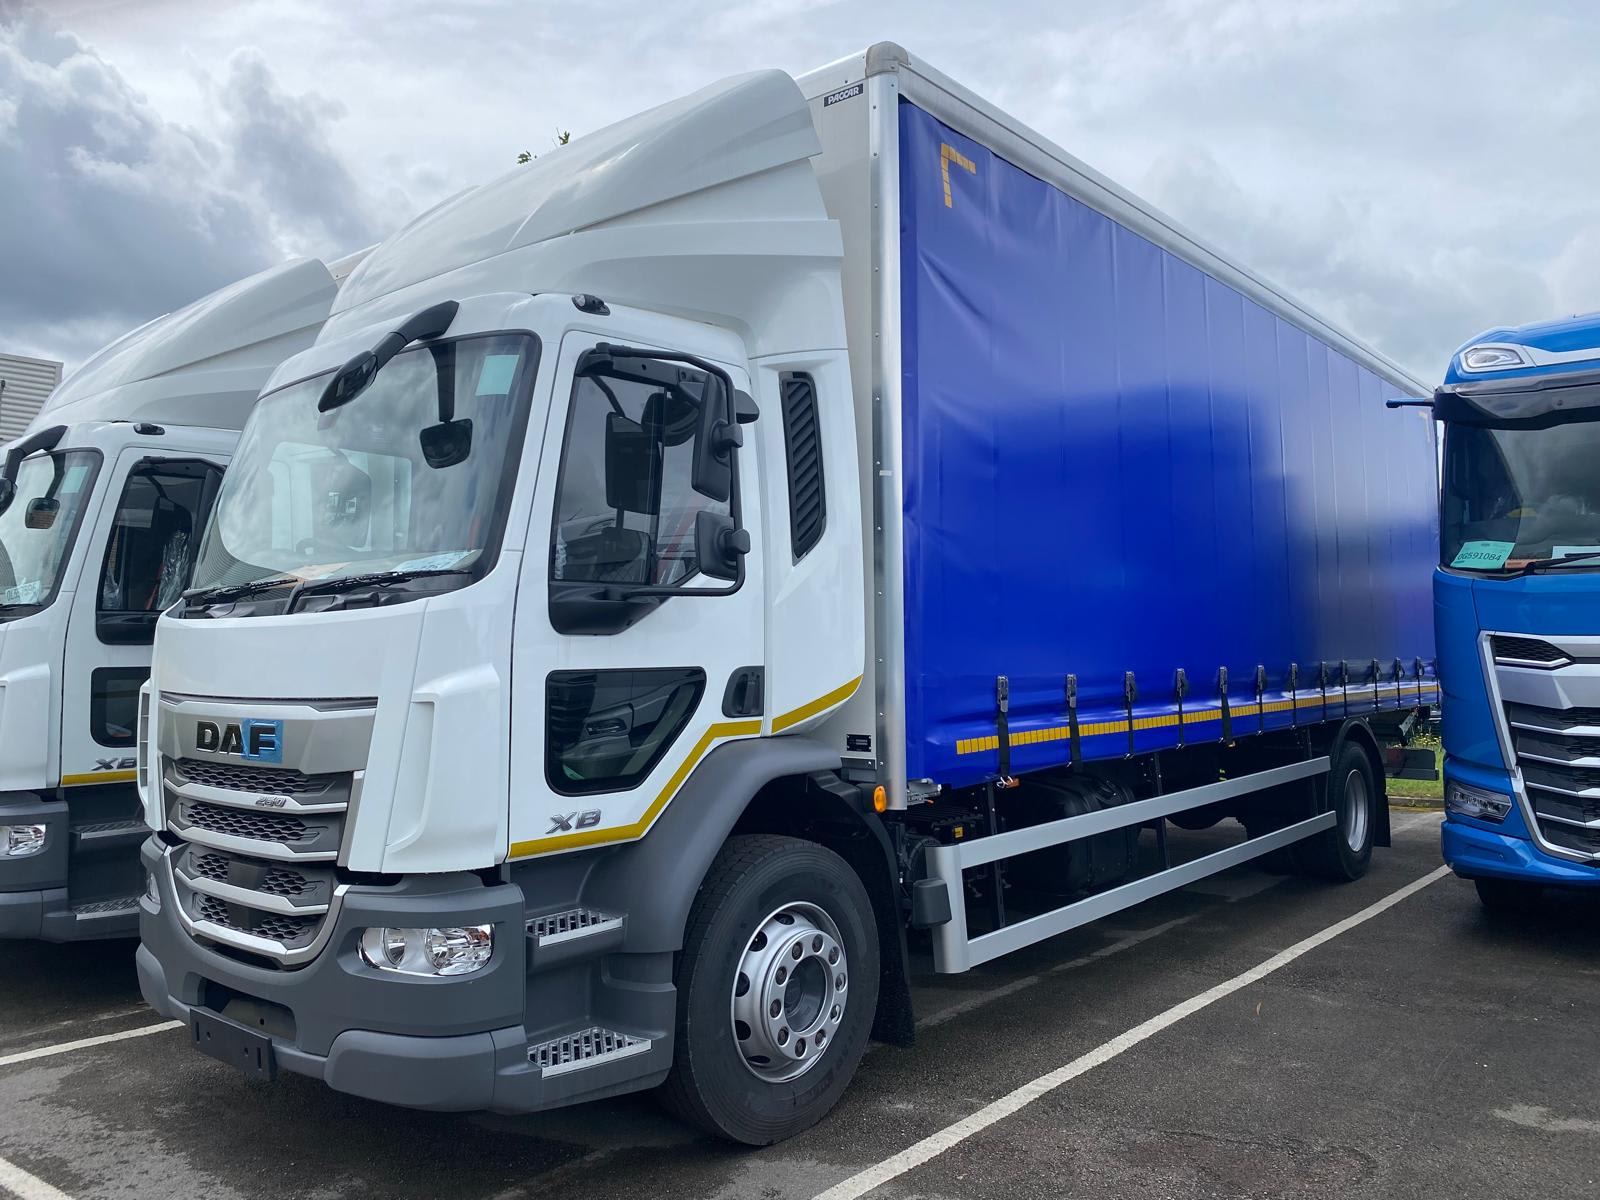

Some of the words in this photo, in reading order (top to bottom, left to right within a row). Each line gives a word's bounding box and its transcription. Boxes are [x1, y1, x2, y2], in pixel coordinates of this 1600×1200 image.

[828, 86, 859, 105] PACCAR
[196, 720, 276, 757] DAF
[91, 757, 137, 771] XB
[545, 809, 602, 834] XB
